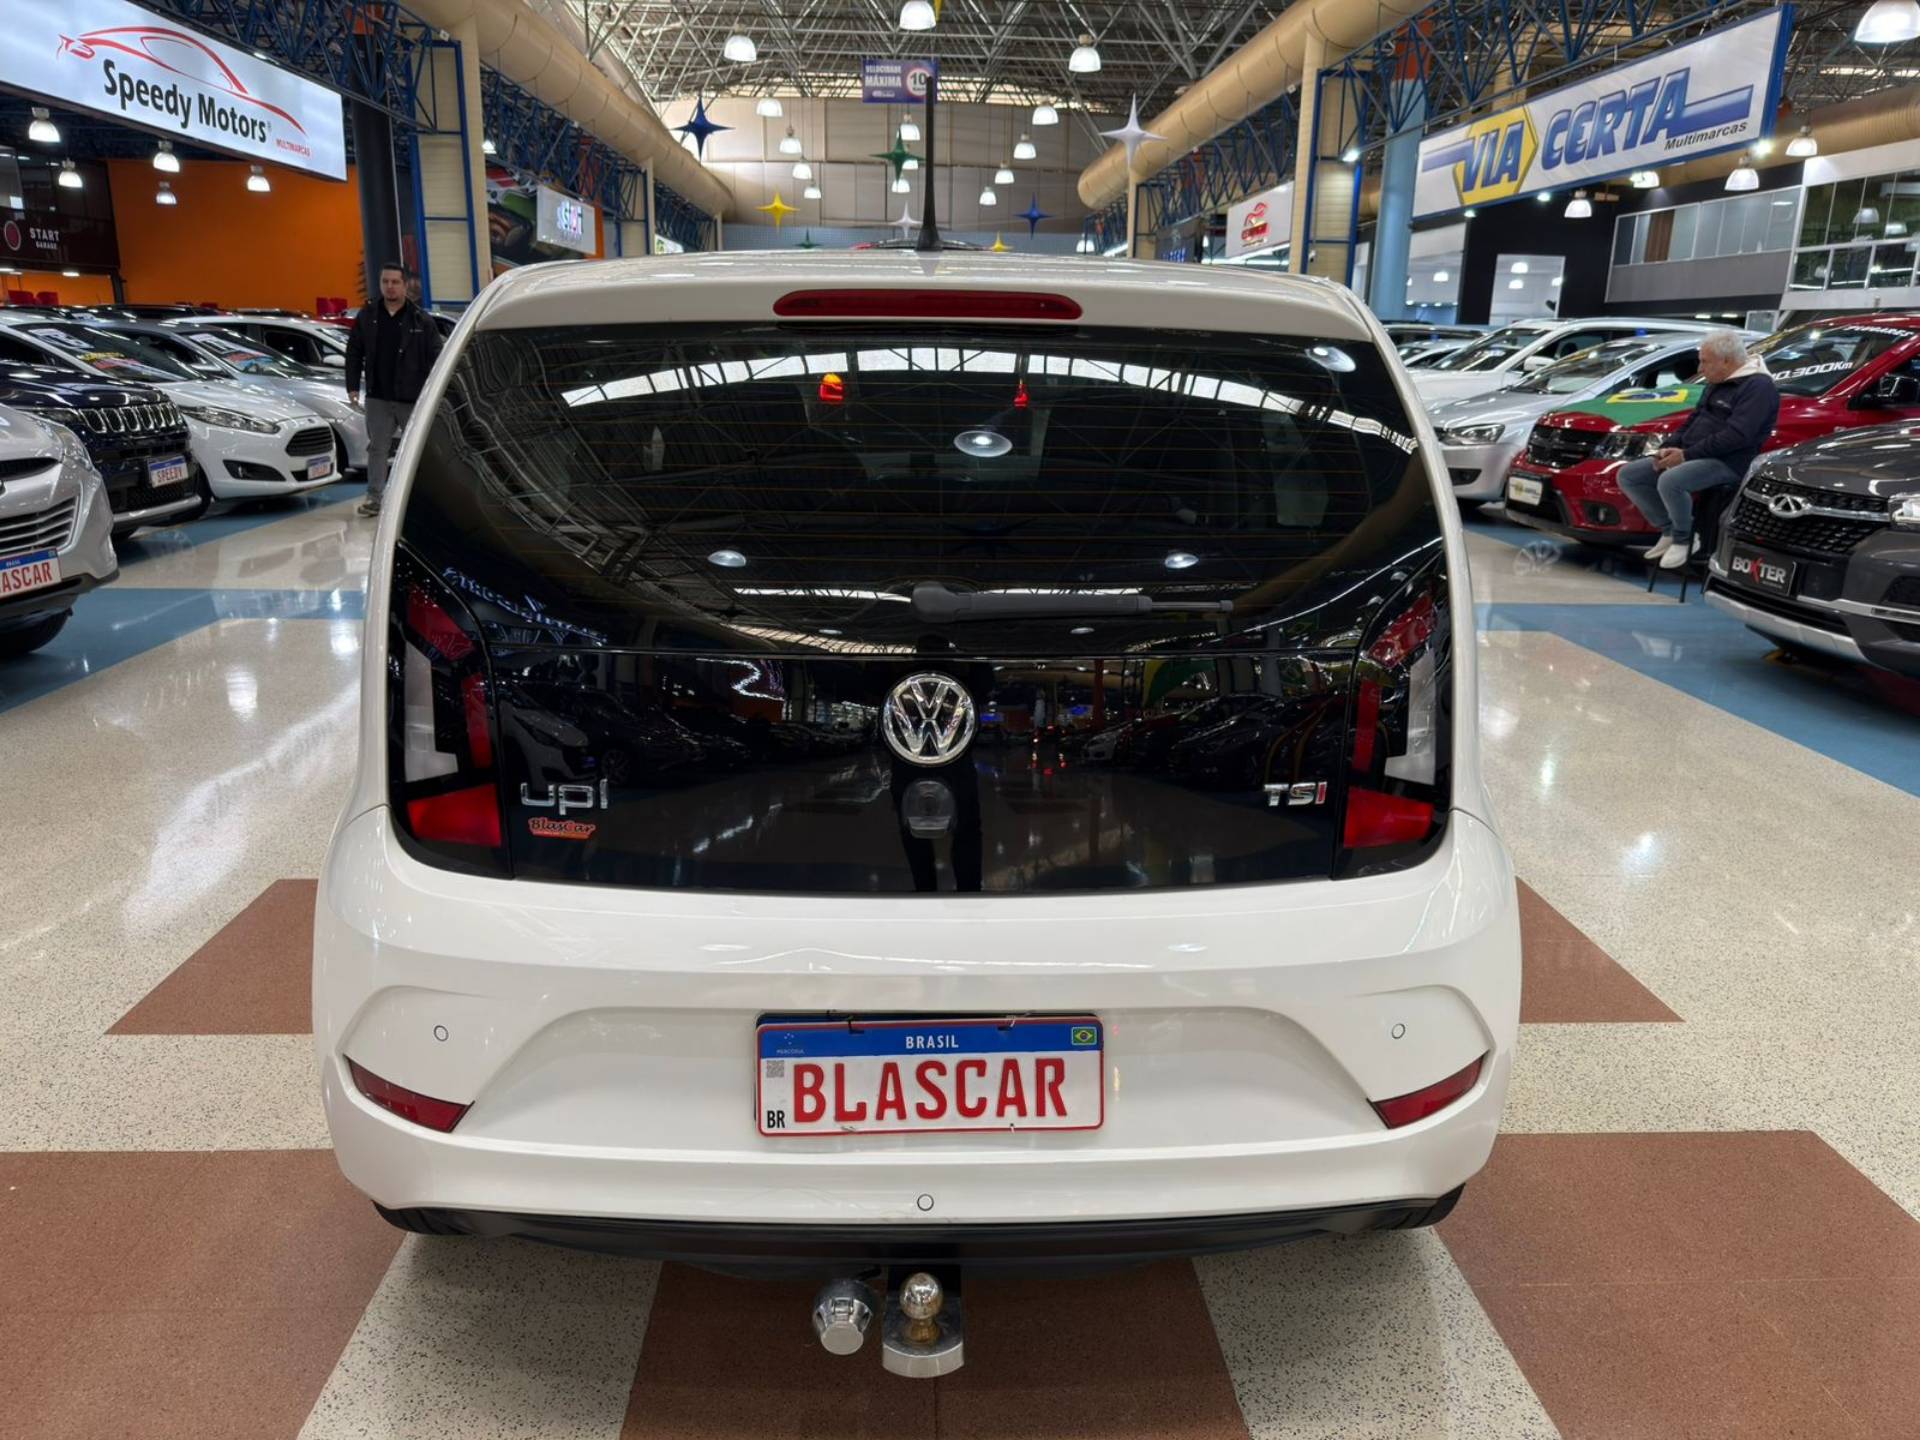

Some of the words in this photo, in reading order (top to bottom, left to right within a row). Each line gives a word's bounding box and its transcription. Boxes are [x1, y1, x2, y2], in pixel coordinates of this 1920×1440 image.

[865, 65, 901, 74] VELOCIDADE
[911, 72, 927, 86] 10
[865, 75, 902, 87] MÁXIMA
[103, 58, 192, 129] Speedy
[198, 93, 267, 143] Motors
[1461, 121, 1525, 192] VIA
[1541, 67, 1691, 170] CERTA
[1664, 119, 1748, 151] Multimarcas
[29, 227, 60, 241] START
[157, 467, 184, 483] SPEEDY
[0, 562, 53, 594] ASCAR
[1732, 554, 1787, 584] BOXTER
[905, 1034, 960, 1049] BRASIL
[793, 1057, 1067, 1123] BLASCAR
[767, 1109, 786, 1129] BR
